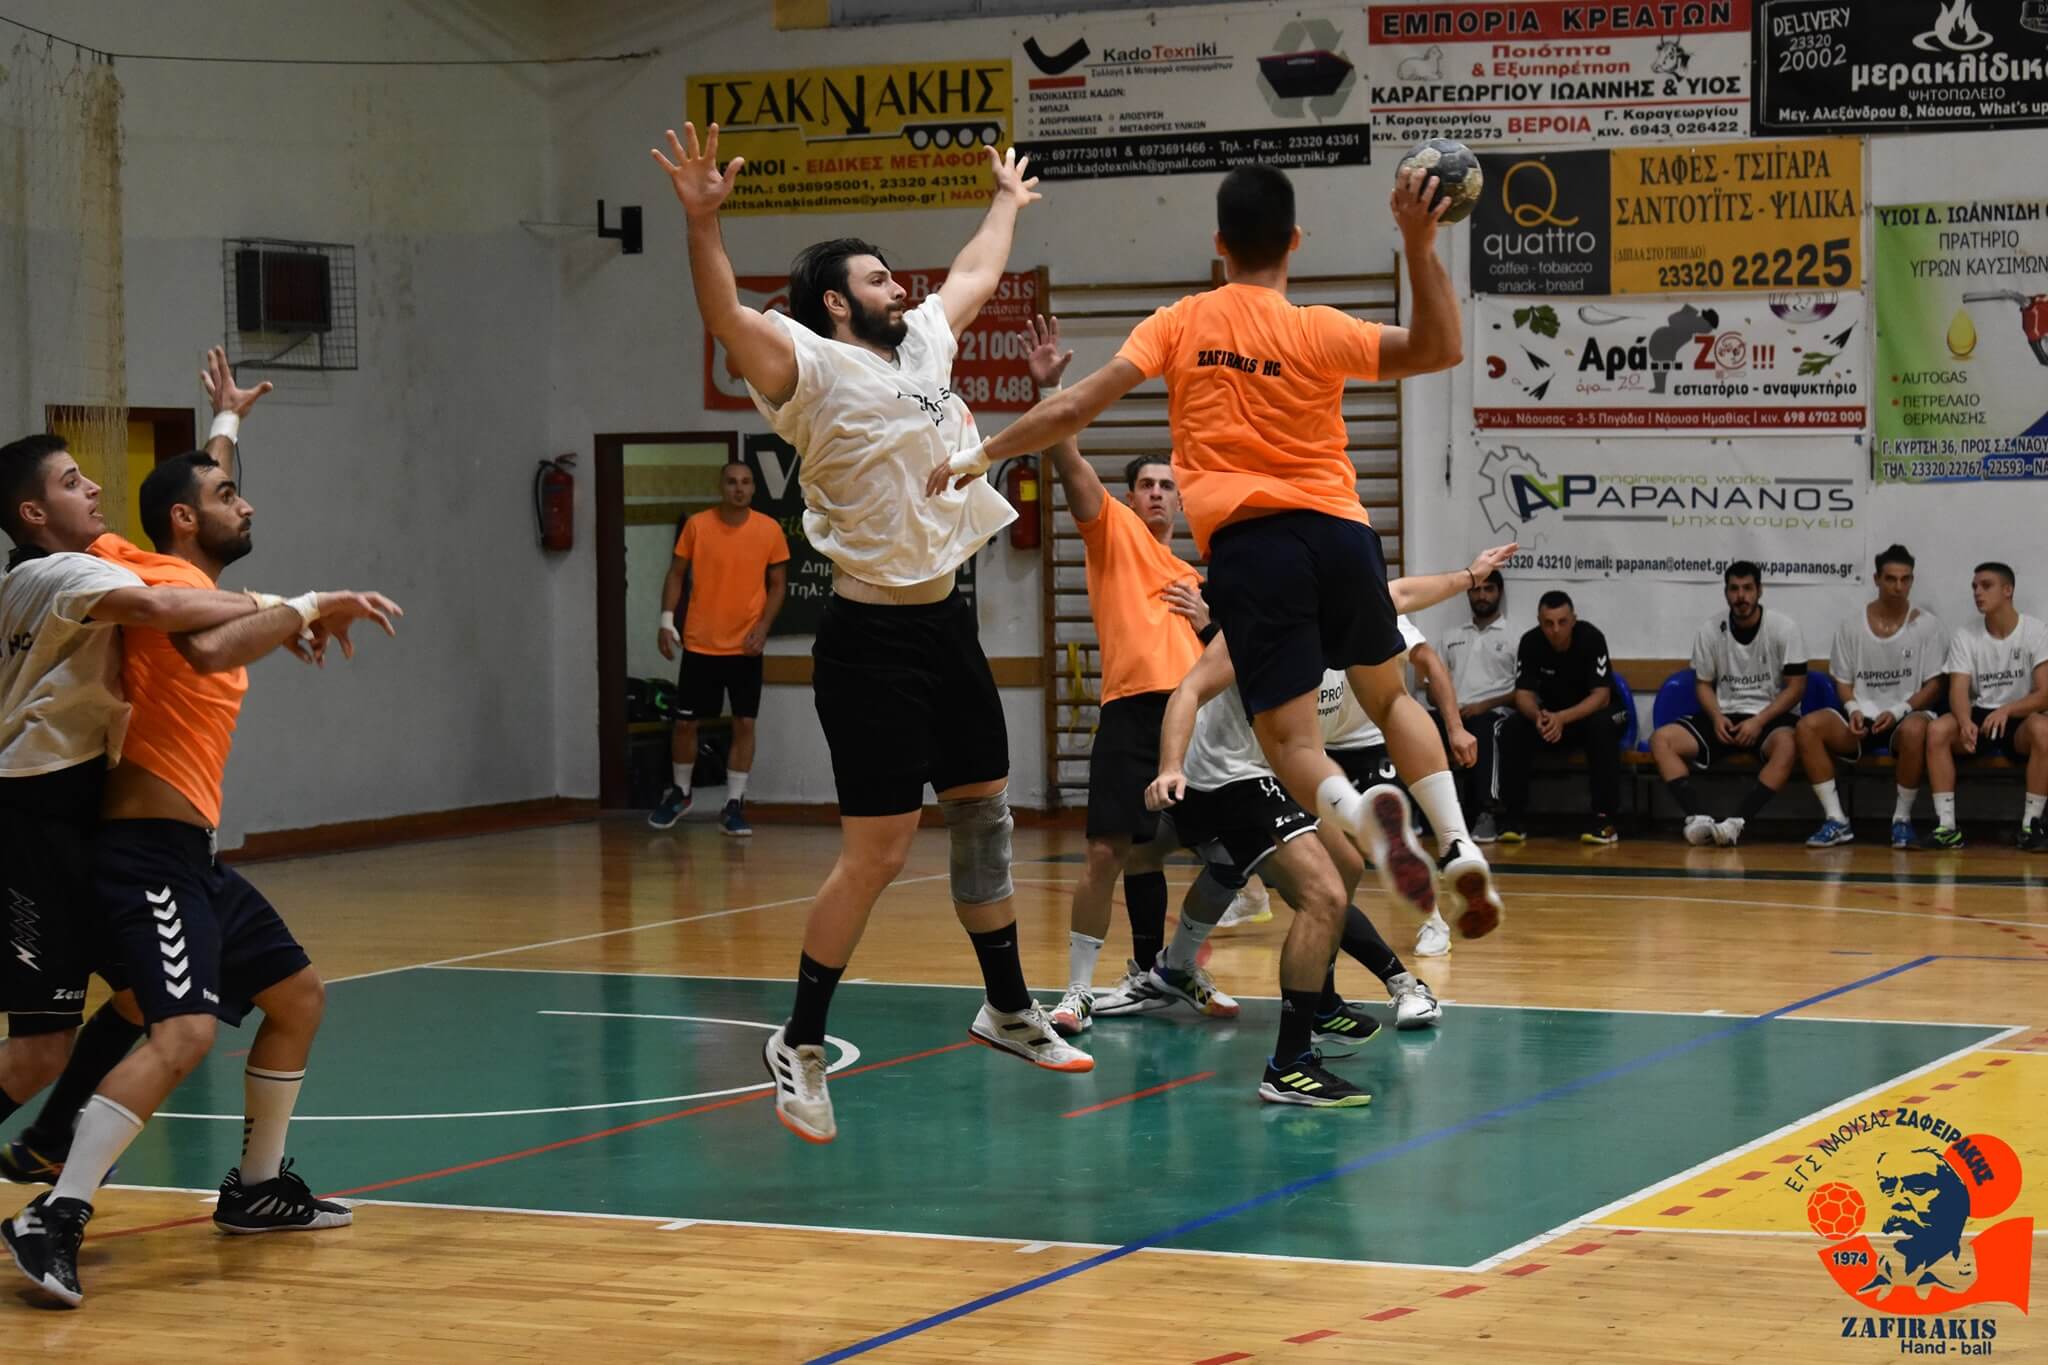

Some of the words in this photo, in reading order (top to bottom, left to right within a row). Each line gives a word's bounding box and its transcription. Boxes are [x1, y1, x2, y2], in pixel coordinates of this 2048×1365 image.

[1383, 9, 1541, 36] ΕΜΠΟΡΙΑ
[1563, 2, 1732, 32] ΚΡΕΑΤΩΝ
[1773, 7, 1850, 37] DELIVERY
[1491, 44, 1612, 58] Ποιότητα
[1789, 34, 1832, 51] 23320
[1103, 42, 1218, 63] KadoTexniki
[1779, 43, 1847, 73] 20002
[1471, 63, 1485, 77] &
[1493, 60, 1631, 79] Εξυπηρέτηση
[1851, 51, 2048, 92] μερακλίδικ
[1371, 83, 1543, 104] ΚΑΡΑΓΕΩΡΓΙΟΥ
[1550, 80, 1655, 101] ΙΩΑΝΝΗΣ
[1662, 79, 1678, 96] &
[1686, 76, 1741, 95] ΥΙΟΣ
[1908, 86, 2006, 101] ΨΗΤΟΠΩΛΕΙΟ
[698, 68, 1005, 134] ΤΣΑΚΝΑΚΗΣ
[1779, 108, 1810, 121] Μεγ.
[1813, 104, 1896, 121] Αλεξάνδρου
[1900, 106, 1913, 119] 8,
[1916, 102, 1976, 119] Νάουσα,
[1979, 100, 2028, 116] What's
[1386, 113, 1492, 127] Καραγεωργίου
[1604, 109, 1618, 121] Γ.
[1623, 107, 1738, 121] Καραγεωργίου
[1508, 115, 1591, 134] ΒΕΡΟΙΑ
[1597, 128, 1624, 138] κιν.
[1630, 123, 1671, 135] 6943
[1676, 121, 1738, 134] 026422
[1372, 132, 1396, 141] κιν.
[1401, 129, 1439, 140] 6972
[1444, 128, 1503, 140] 222573
[1124, 145, 1134, 157] &
[1288, 135, 1323, 149] 23320
[1325, 133, 1360, 146] 43361
[806, 155, 884, 175] ΕΙΔΙΚΕΣ
[890, 151, 992, 169] ΜΕΤΑΦΟΡ
[1640, 154, 1718, 186] ΚΑΦΕΣ
[1735, 150, 1831, 182] ΤΣΙΓΑΡΑ
[880, 177, 926, 189] 23320
[931, 175, 977, 186] 43131
[720, 191, 936, 210] ail:tsaknakisdimos@yahoo.gr
[1616, 187, 1753, 226] ΣΑΝΤΟΥΪΤΣ
[1769, 188, 1856, 220] ΨΙΛΙΚΑ
[1880, 208, 1920, 226] ΥΙΟΙ
[1926, 207, 1942, 225] Δ.
[1483, 227, 1596, 261] quattro
[1939, 230, 2020, 250] ΠΡΑΤΗΡΙΟ
[1489, 262, 1528, 275] coffee
[1539, 261, 1593, 274] tobacco
[1658, 258, 1724, 287] 23320
[1732, 237, 1852, 287] 22225
[1910, 258, 1961, 278] ΥΓΡΩΝ
[1966, 255, 2048, 276] ΚΑΥΣΙΜΩΝ
[1497, 279, 1536, 292] snack
[1545, 278, 1585, 292] bread
[1198, 350, 1258, 374] ZAFIRAKIS
[1262, 359, 1281, 377] HC
[1902, 370, 1967, 384] AUTOGAS
[994, 375, 1034, 403] 488
[1673, 381, 1749, 399] εστιατόριο
[1763, 379, 1857, 398] αναψυκτήριο
[1903, 393, 1980, 408] ΠΕΤΡΕΛΑΙΟ
[1576, 412, 1596, 424] 3-5
[1807, 411, 1837, 423] 6702
[1839, 411, 1862, 423] 000
[1903, 411, 1987, 426] ΘΕΡΜΑΝΣΗΣ
[1895, 439, 1938, 455] ΚΥΡΤΣΗ
[1961, 438, 1991, 453] ΠΡΟΣ
[1911, 461, 1945, 476] 23320
[1989, 460, 2023, 474] 22593
[1564, 475, 1853, 511] PAPANANOS
[1537, 555, 1571, 569] 43210
